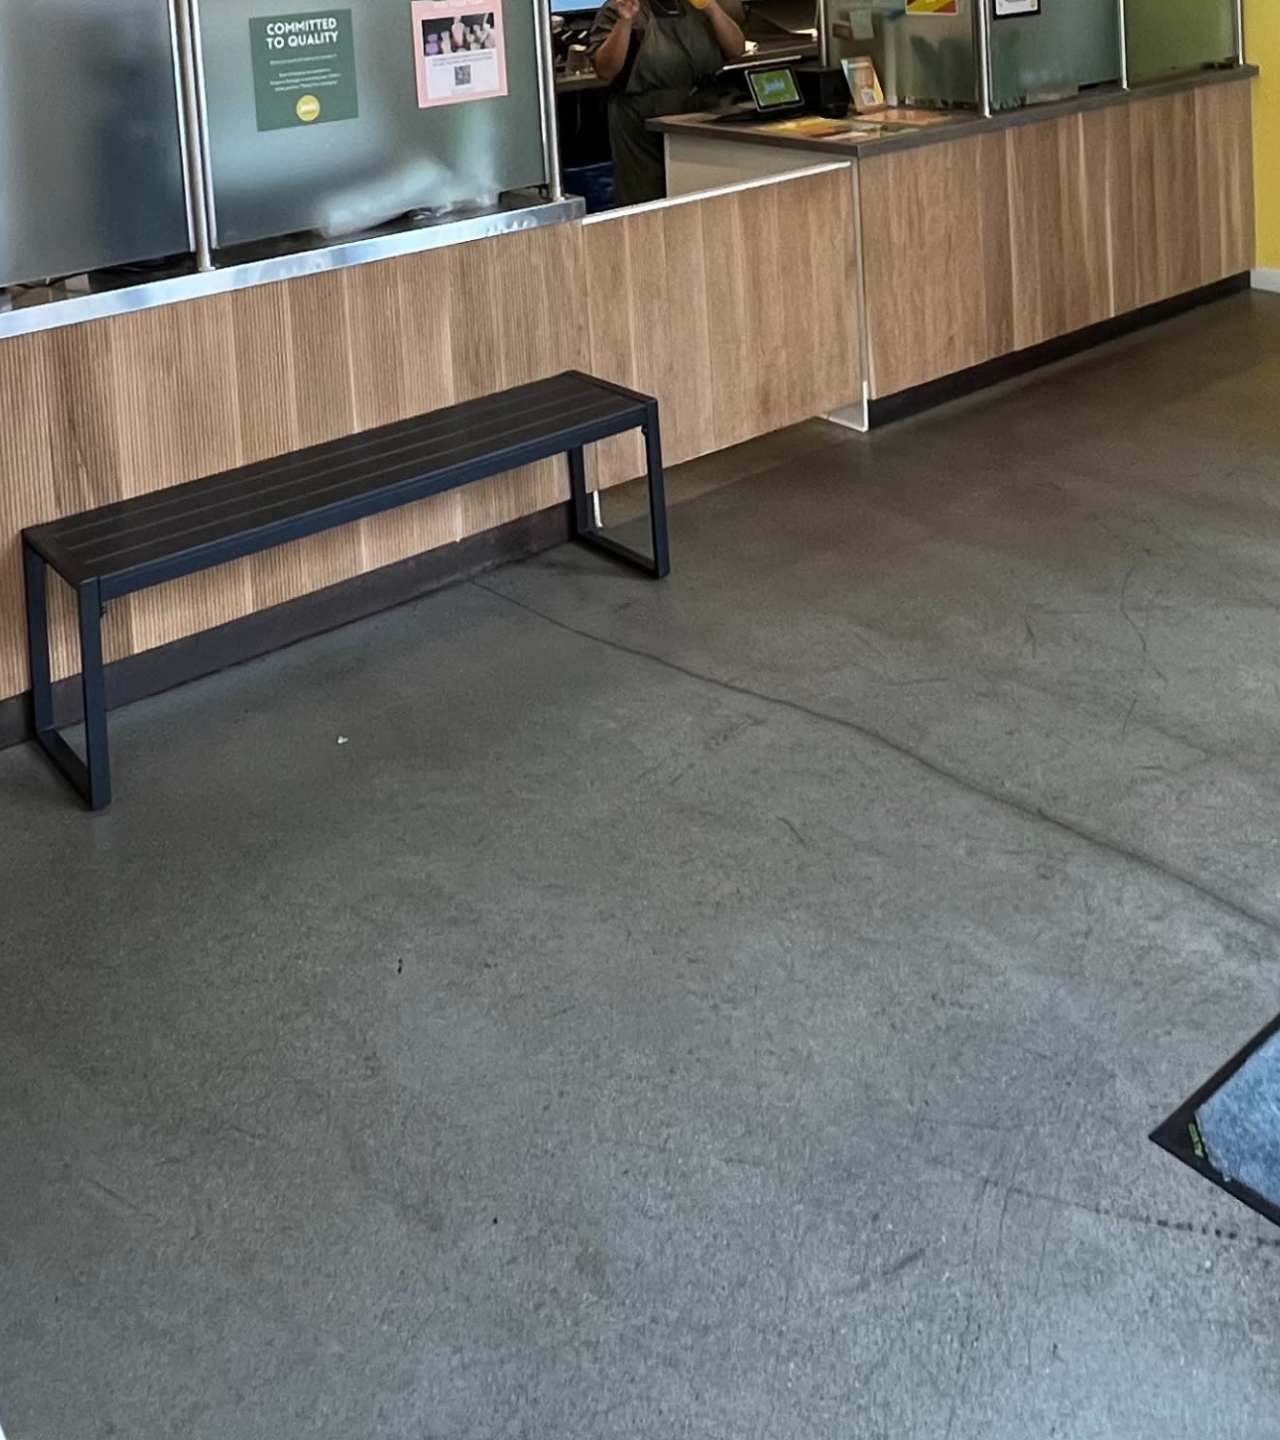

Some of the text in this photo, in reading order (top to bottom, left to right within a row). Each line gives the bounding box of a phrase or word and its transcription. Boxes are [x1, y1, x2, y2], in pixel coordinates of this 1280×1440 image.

[265, 17, 338, 36] COMMITTED
[265, 31, 339, 50] TO QUALITY
